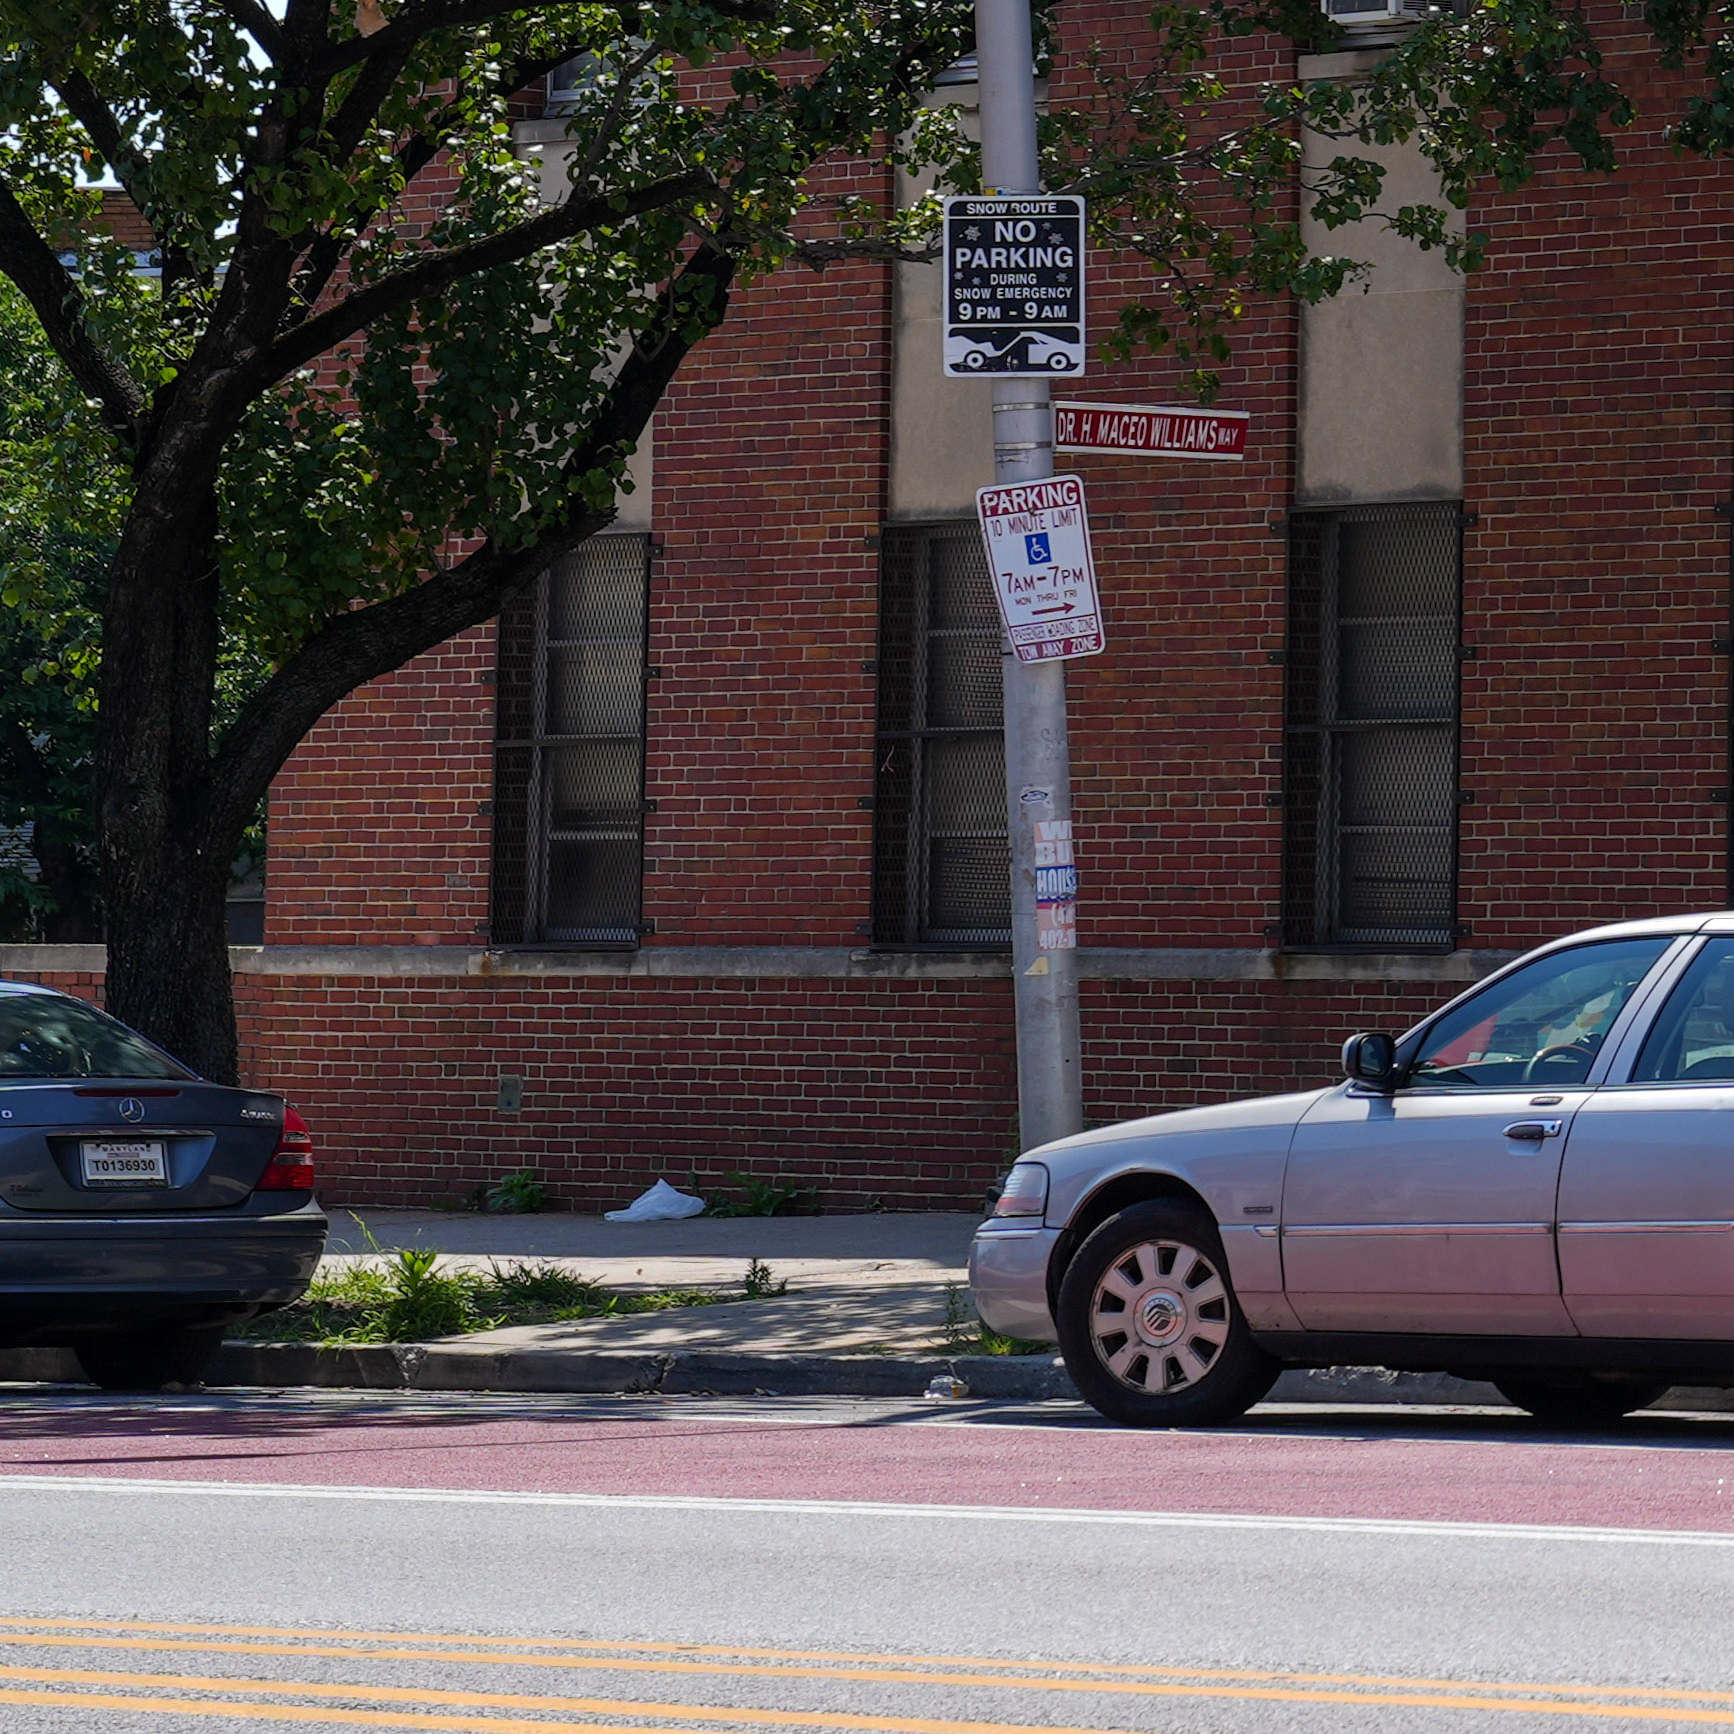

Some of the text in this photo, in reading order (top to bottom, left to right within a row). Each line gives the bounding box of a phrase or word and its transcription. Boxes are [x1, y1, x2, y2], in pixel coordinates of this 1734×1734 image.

[966, 202, 1057, 214] SNOW ROUTE
[994, 220, 1037, 242] NO
[956, 246, 1074, 268] PARKING
[990, 274, 1037, 285] DURING
[954, 287, 1072, 300] SNOW EMERGENCY
[1058, 412, 1239, 450] DR. H. MACEO WILLIAMS WAY
[983, 482, 1078, 516] PARKING
[990, 508, 1078, 537] 10 MINUTE LIMIT
[1014, 590, 1078, 606] MON THRU FRI
[1078, 618, 1095, 632] ZONE
[1018, 636, 1098, 661] TOW AWAY ZONE
[92, 1160, 155, 1171] T0136930
